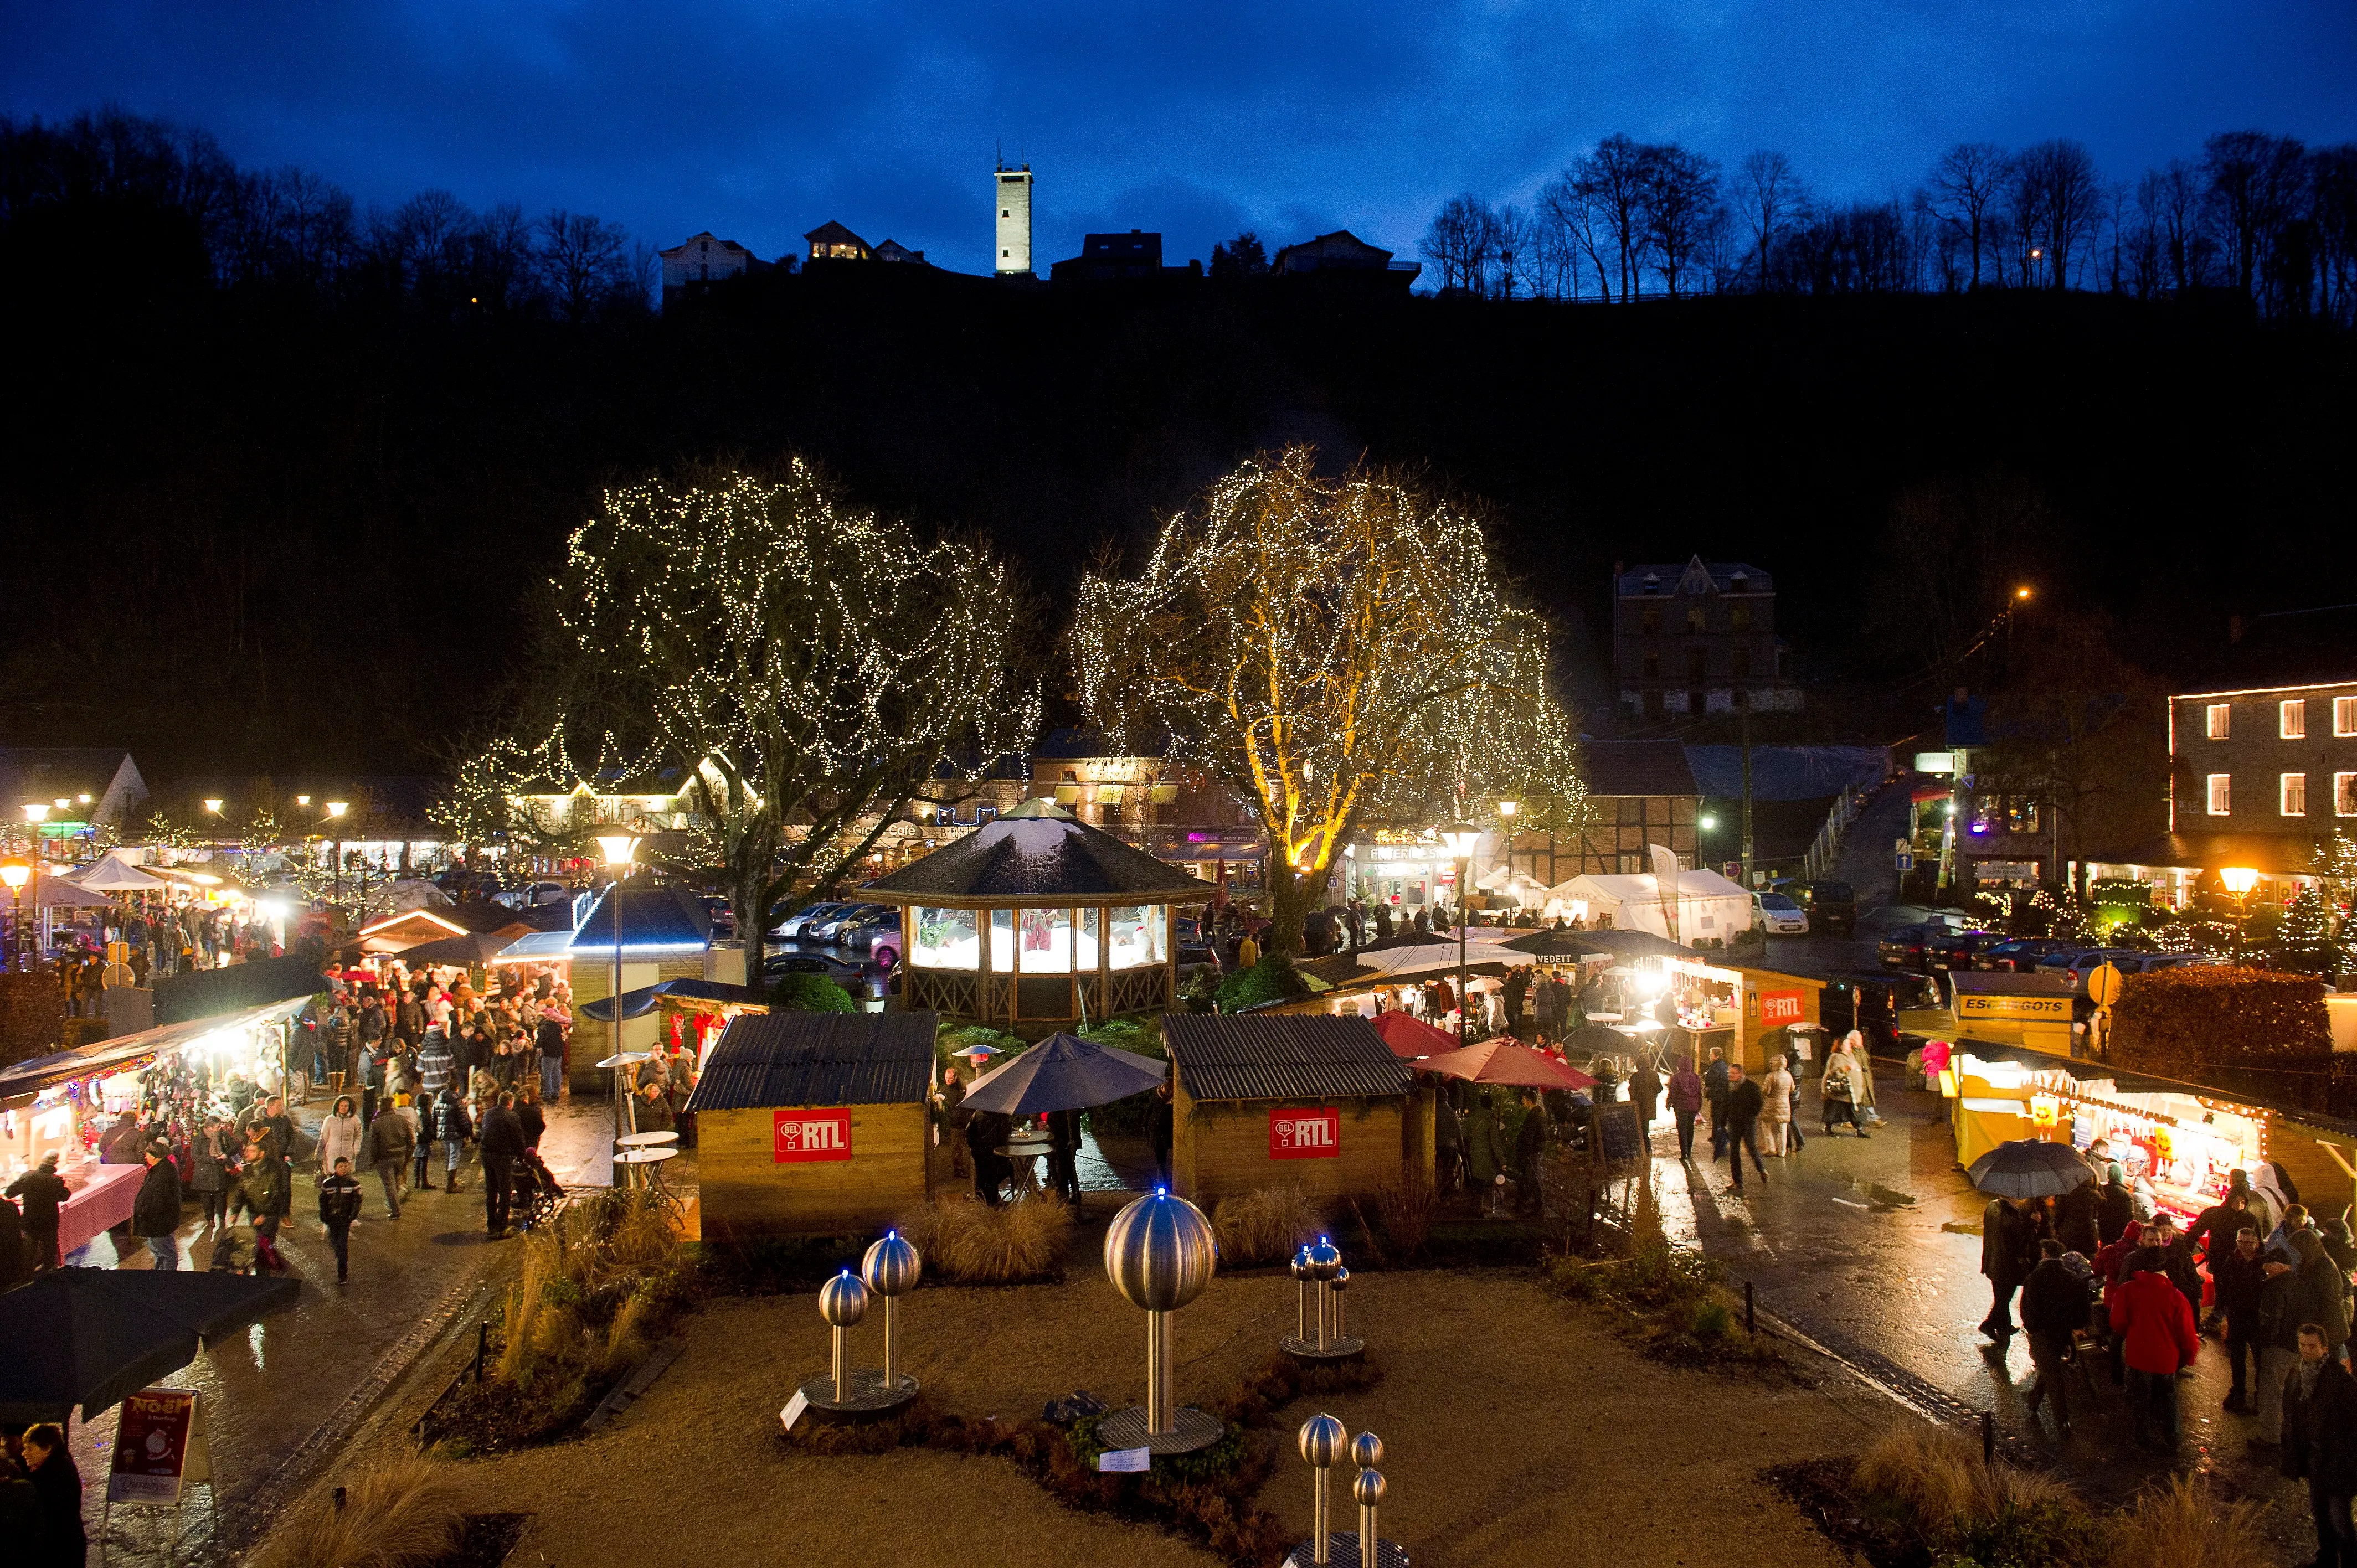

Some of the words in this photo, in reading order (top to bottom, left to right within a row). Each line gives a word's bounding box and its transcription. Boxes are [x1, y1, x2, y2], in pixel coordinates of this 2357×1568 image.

[889, 824, 915, 836] Café
[1537, 955, 1571, 963] VEDETT
[1777, 998, 1800, 1017] RTL
[1965, 999, 2063, 1012] ESCARGOTS
[784, 1125, 798, 1134] BEL
[802, 1121, 845, 1149] RTL
[1278, 1124, 1291, 1132] BEL
[1295, 1120, 1333, 1146] RTL
[131, 1397, 182, 1414] Noël
